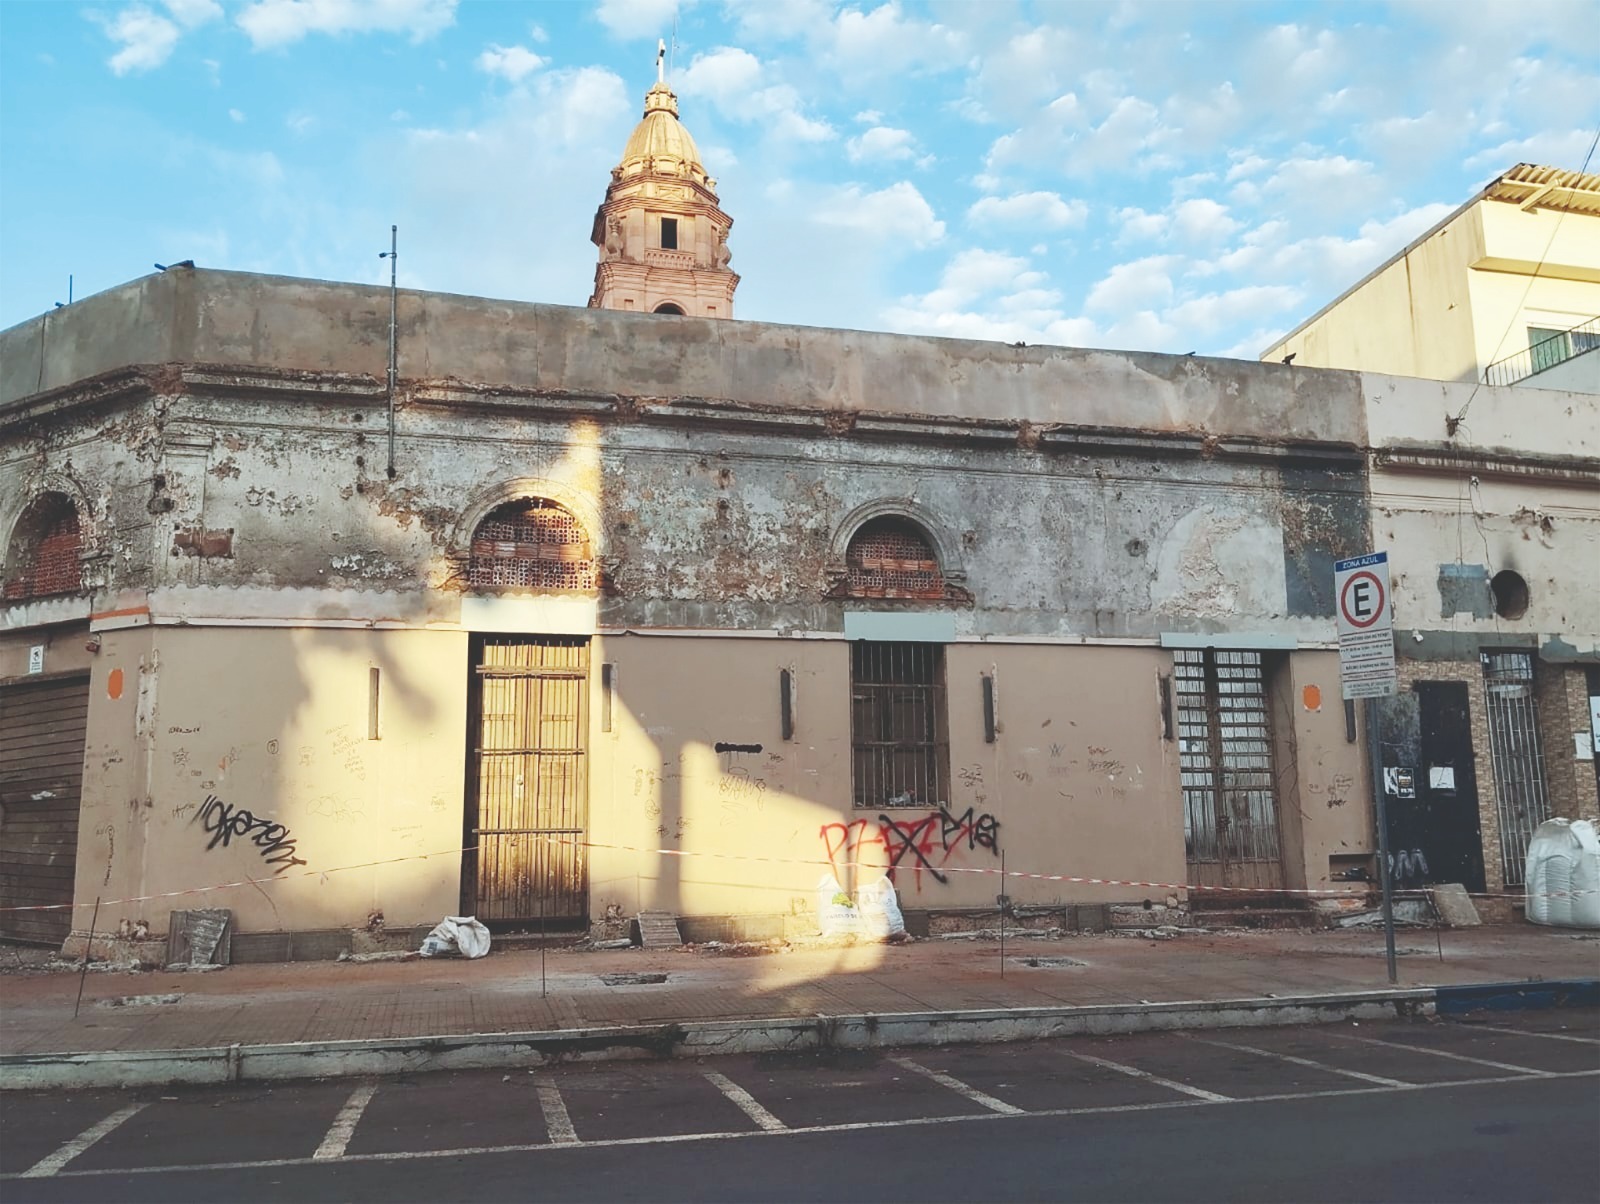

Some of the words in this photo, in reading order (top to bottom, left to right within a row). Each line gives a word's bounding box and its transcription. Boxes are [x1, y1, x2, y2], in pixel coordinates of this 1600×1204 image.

[1343, 559, 1360, 569] ZONA
[1361, 556, 1379, 565] AZUL
[1353, 582, 1371, 616] E
